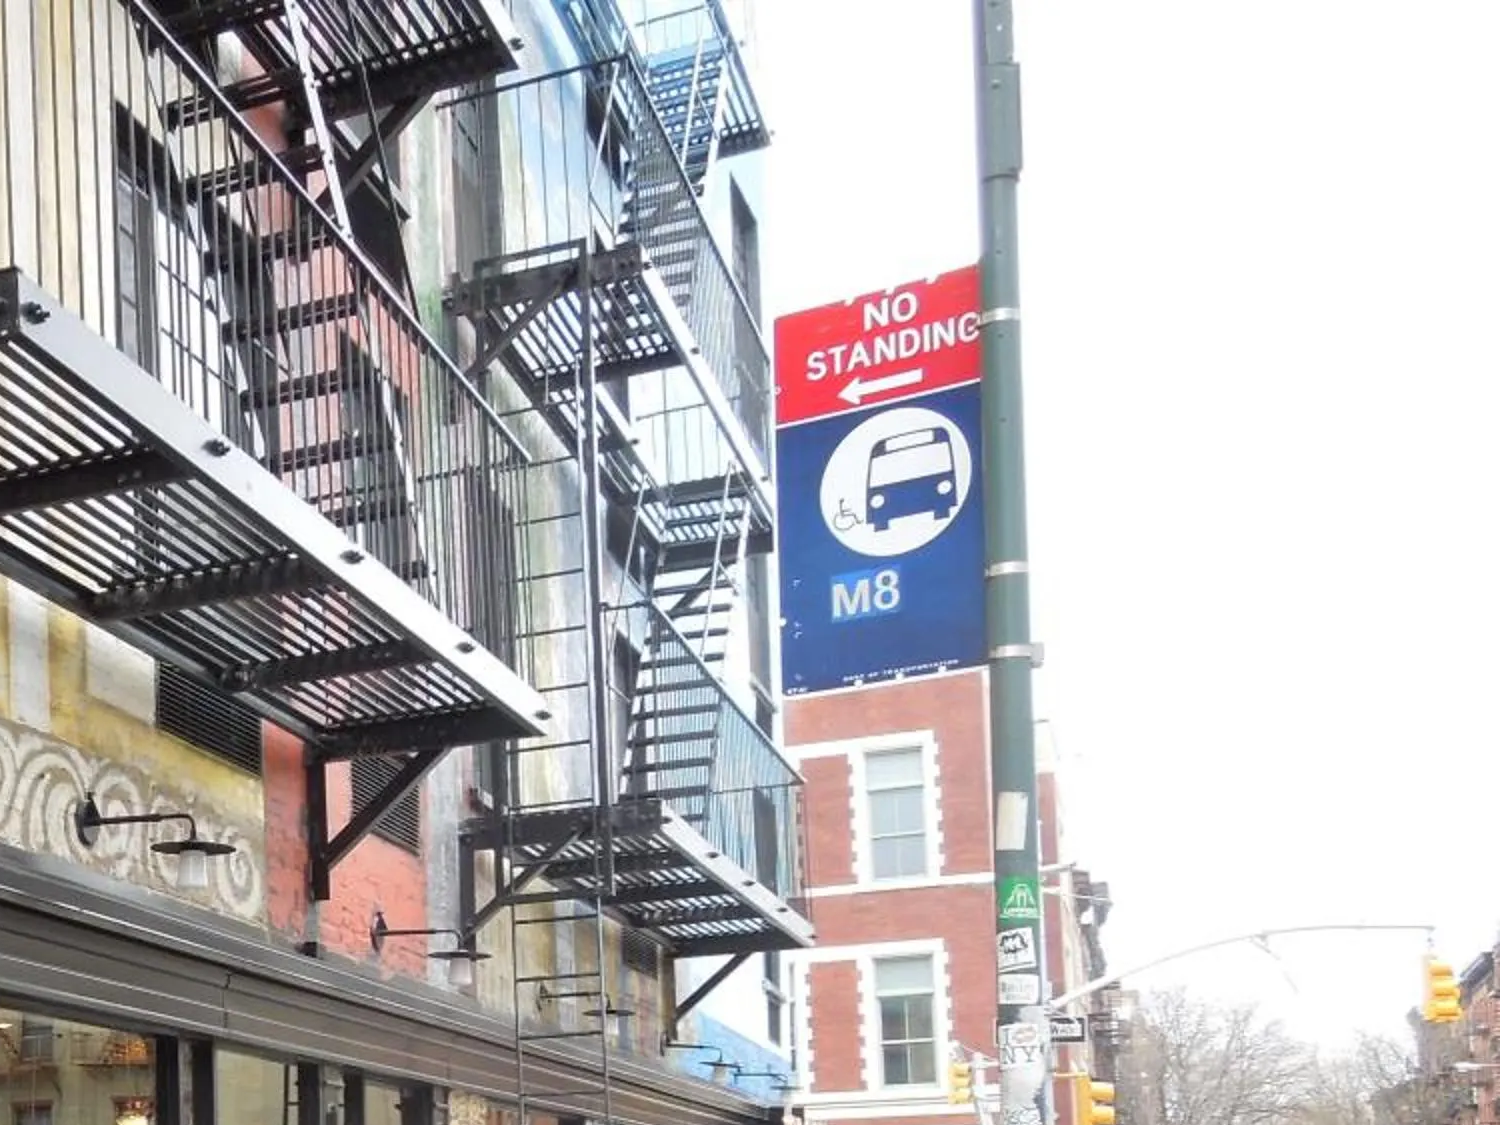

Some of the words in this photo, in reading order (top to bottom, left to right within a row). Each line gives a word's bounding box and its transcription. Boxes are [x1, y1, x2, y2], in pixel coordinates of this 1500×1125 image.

[863, 291, 918, 332] NO
[805, 311, 981, 382] STANDING
[831, 568, 901, 619] M8
